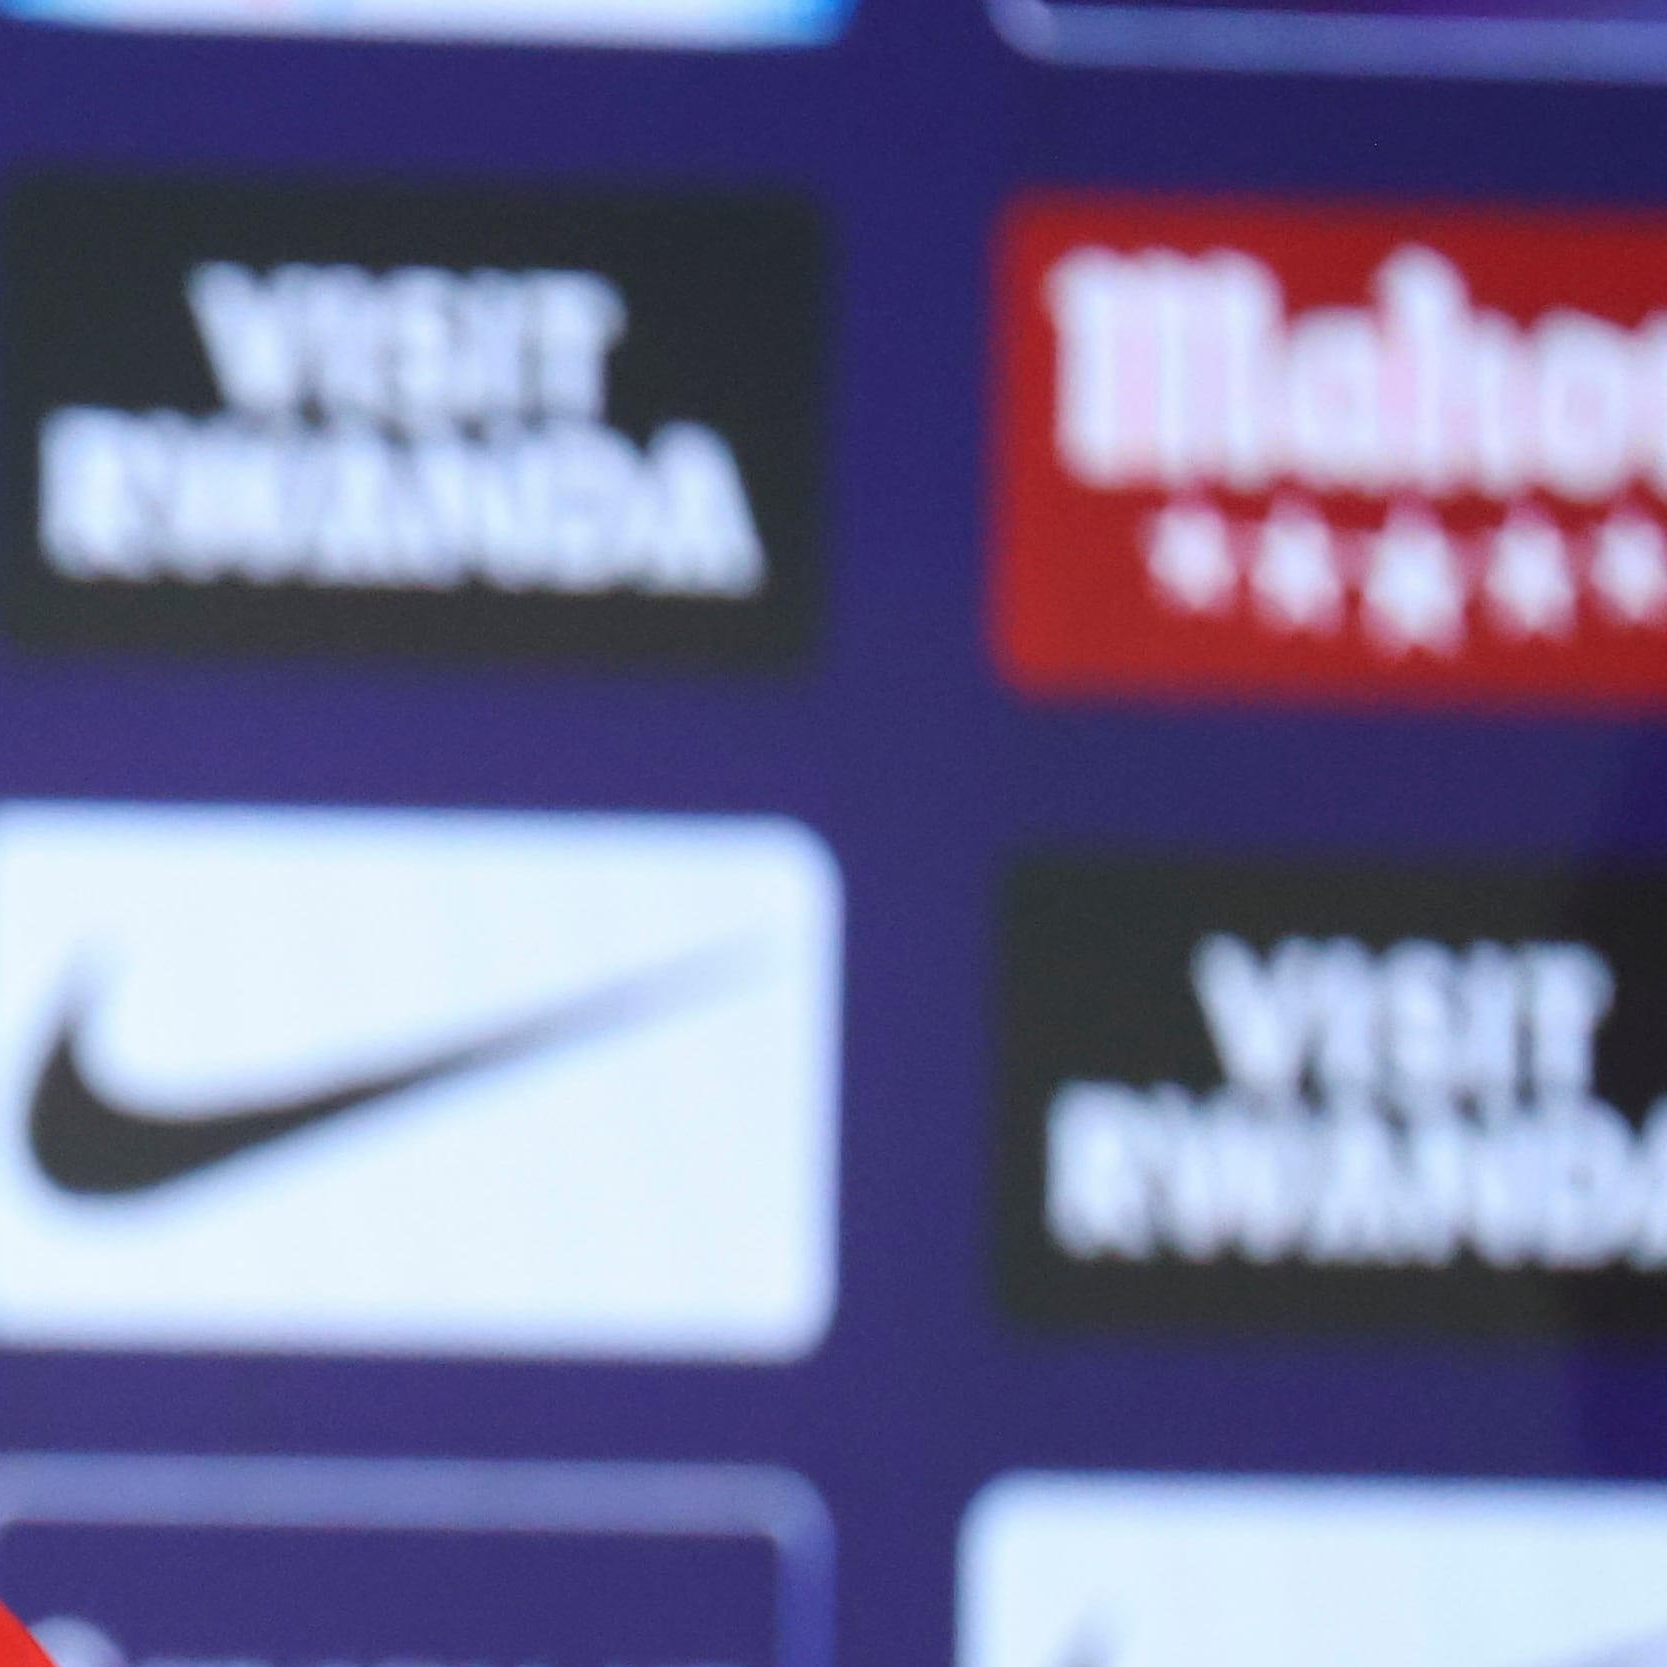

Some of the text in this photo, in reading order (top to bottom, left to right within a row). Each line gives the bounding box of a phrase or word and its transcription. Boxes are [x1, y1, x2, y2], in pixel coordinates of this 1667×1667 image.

[191, 264, 623, 412] VISIT
[1047, 246, 1667, 496] Maho
[40, 408, 763, 594] RWANDA
[1193, 935, 1613, 1098] VISIT
[1047, 1084, 1667, 1266] RWAND
